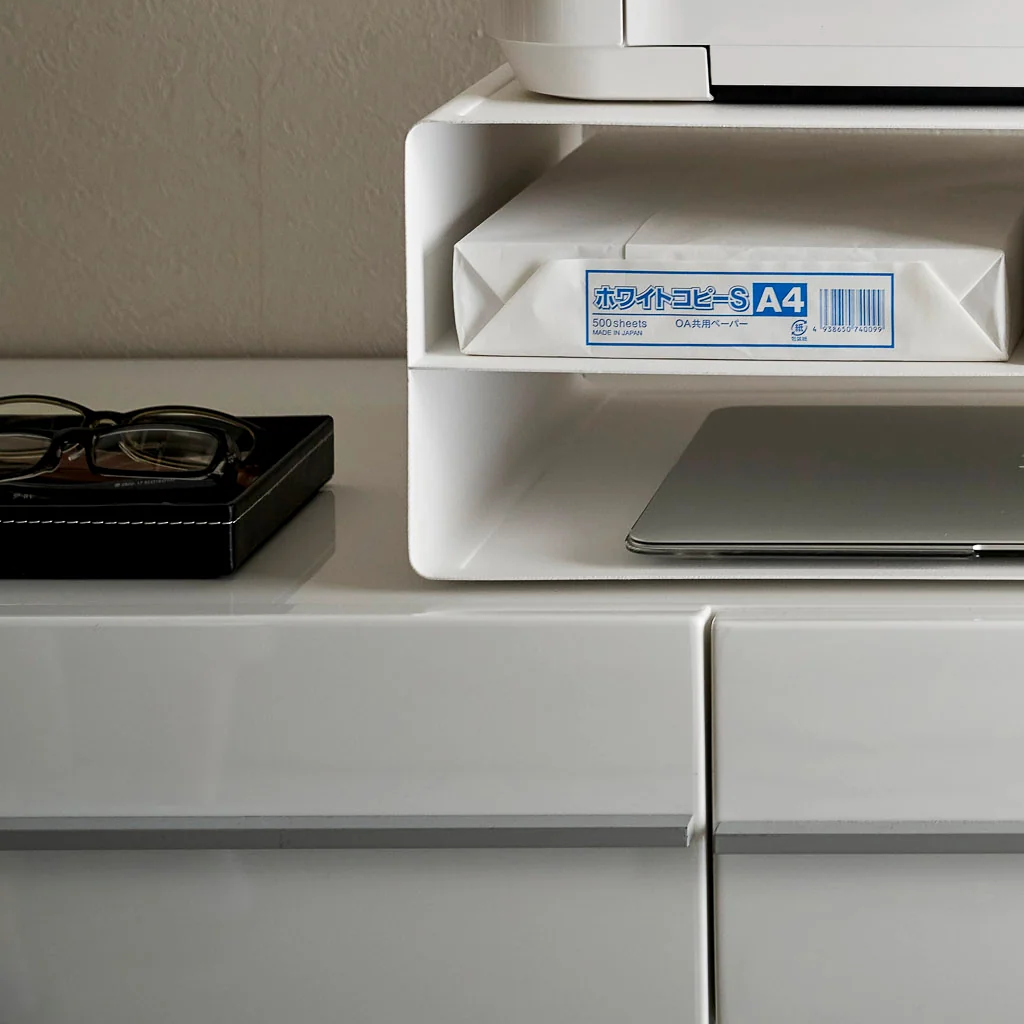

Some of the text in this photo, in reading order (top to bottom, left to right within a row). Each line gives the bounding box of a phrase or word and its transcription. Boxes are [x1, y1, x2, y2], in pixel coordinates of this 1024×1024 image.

[593, 285, 805, 313] ホワイトコピーS A4
[675, 319, 748, 328] OA共用ペーパー
